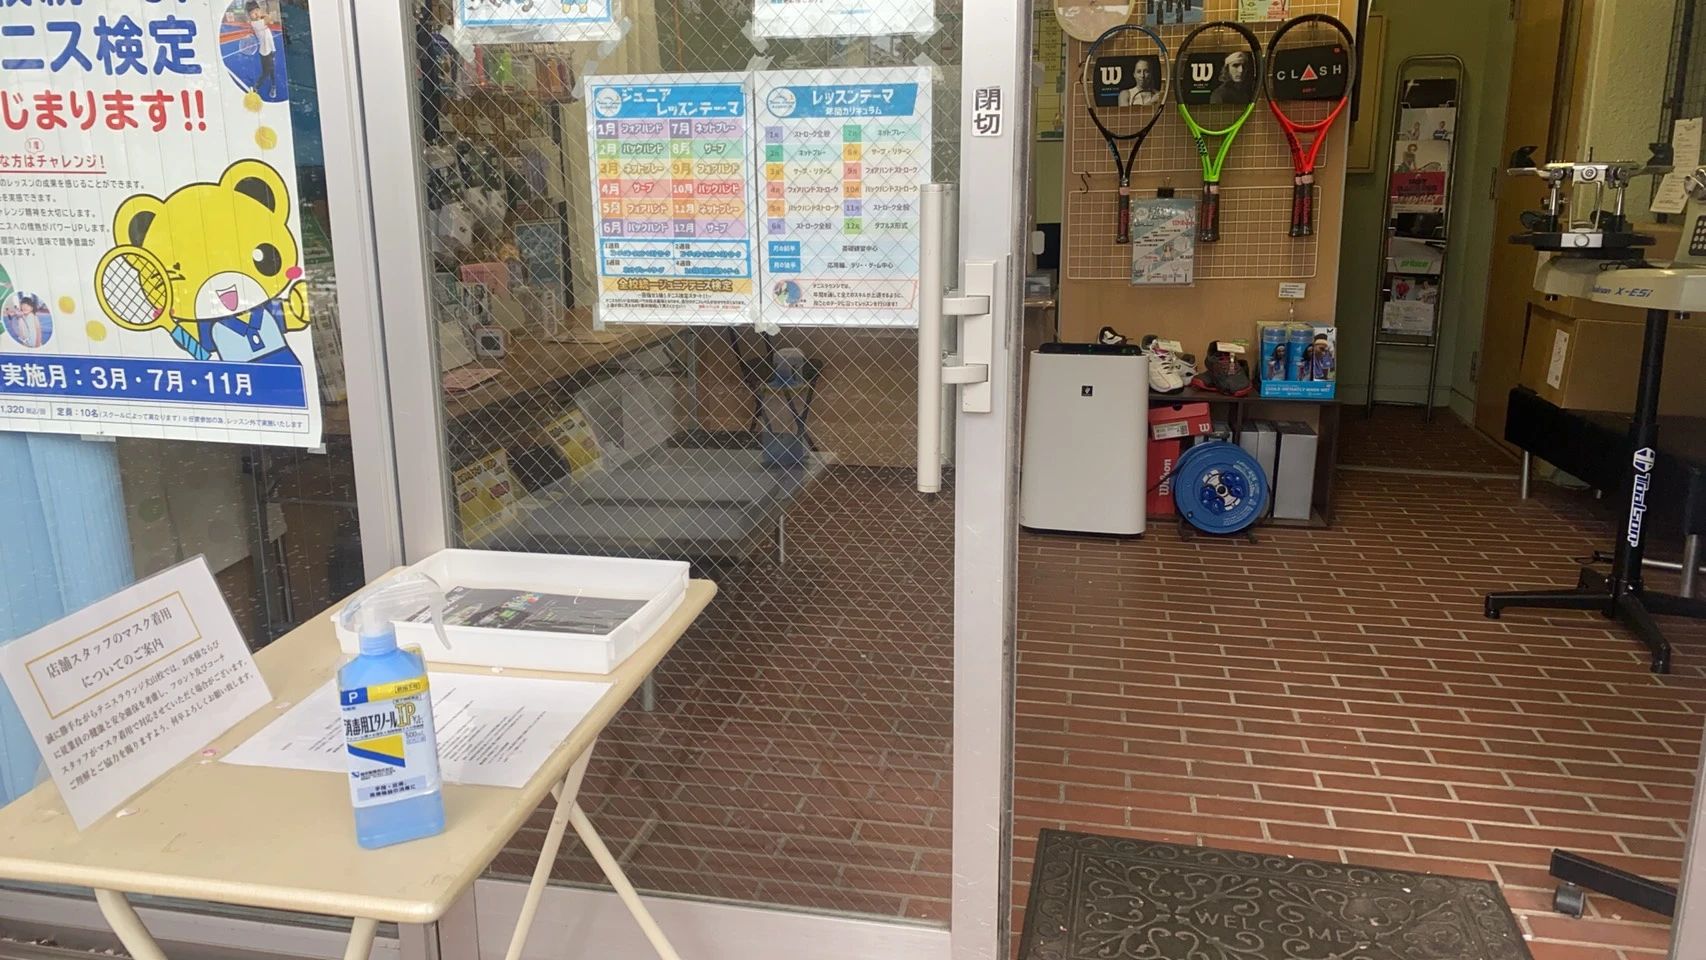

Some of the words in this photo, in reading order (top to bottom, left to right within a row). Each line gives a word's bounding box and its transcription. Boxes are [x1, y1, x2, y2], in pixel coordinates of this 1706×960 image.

[1, 15, 202, 75] ニス検定
[1277, 64, 1342, 81] CLASH
[621, 87, 671, 103] ジュニア
[812, 89, 894, 105] レッスンテーマ
[656, 101, 740, 116] レッスンテーマ
[825, 107, 882, 115] 年間カリキュラム
[974, 88, 1001, 134] 閉切
[598, 123, 616, 135] 1月
[621, 123, 663, 134] フォアハンド
[671, 123, 690, 135] 7月
[694, 123, 736, 134] ネットプレー
[600, 143, 617, 155] 2月
[621, 143, 664, 155] バックハンド
[671, 143, 690, 155] 8月
[703, 143, 725, 154] サーブ
[600, 163, 618, 174] 3月
[623, 164, 664, 174] ネットプレー
[672, 163, 691, 175] 9月
[697, 163, 739, 174] フォアハンド
[601, 184, 620, 195] 4月
[632, 183, 654, 193] サーブ
[673, 183, 693, 194] 10月
[697, 183, 739, 194] バックハンド
[0, 193, 56, 203] を実感できます。
[603, 203, 621, 214] 5月
[627, 204, 668, 215] フォアハンド
[700, 204, 740, 214] ネットプレー
[603, 222, 622, 233] 6月
[627, 223, 668, 233] バックハンド
[674, 223, 694, 233] 12月
[705, 223, 727, 233] サーブ
[0, 247, 35, 256] まります。
[617, 278, 733, 292] 全校統一ジュニアテニス検定
[1, 405, 24, 414] 1,320
[1629, 473, 1650, 546] Toalson
[46, 607, 172, 680] 店舗スタッフのマスク着用
[81, 637, 165, 689] についてのご案内
[349, 691, 359, 703] P
[343, 711, 398, 737] 消毒用エタノール
[1195, 910, 1351, 943] WELCOME
